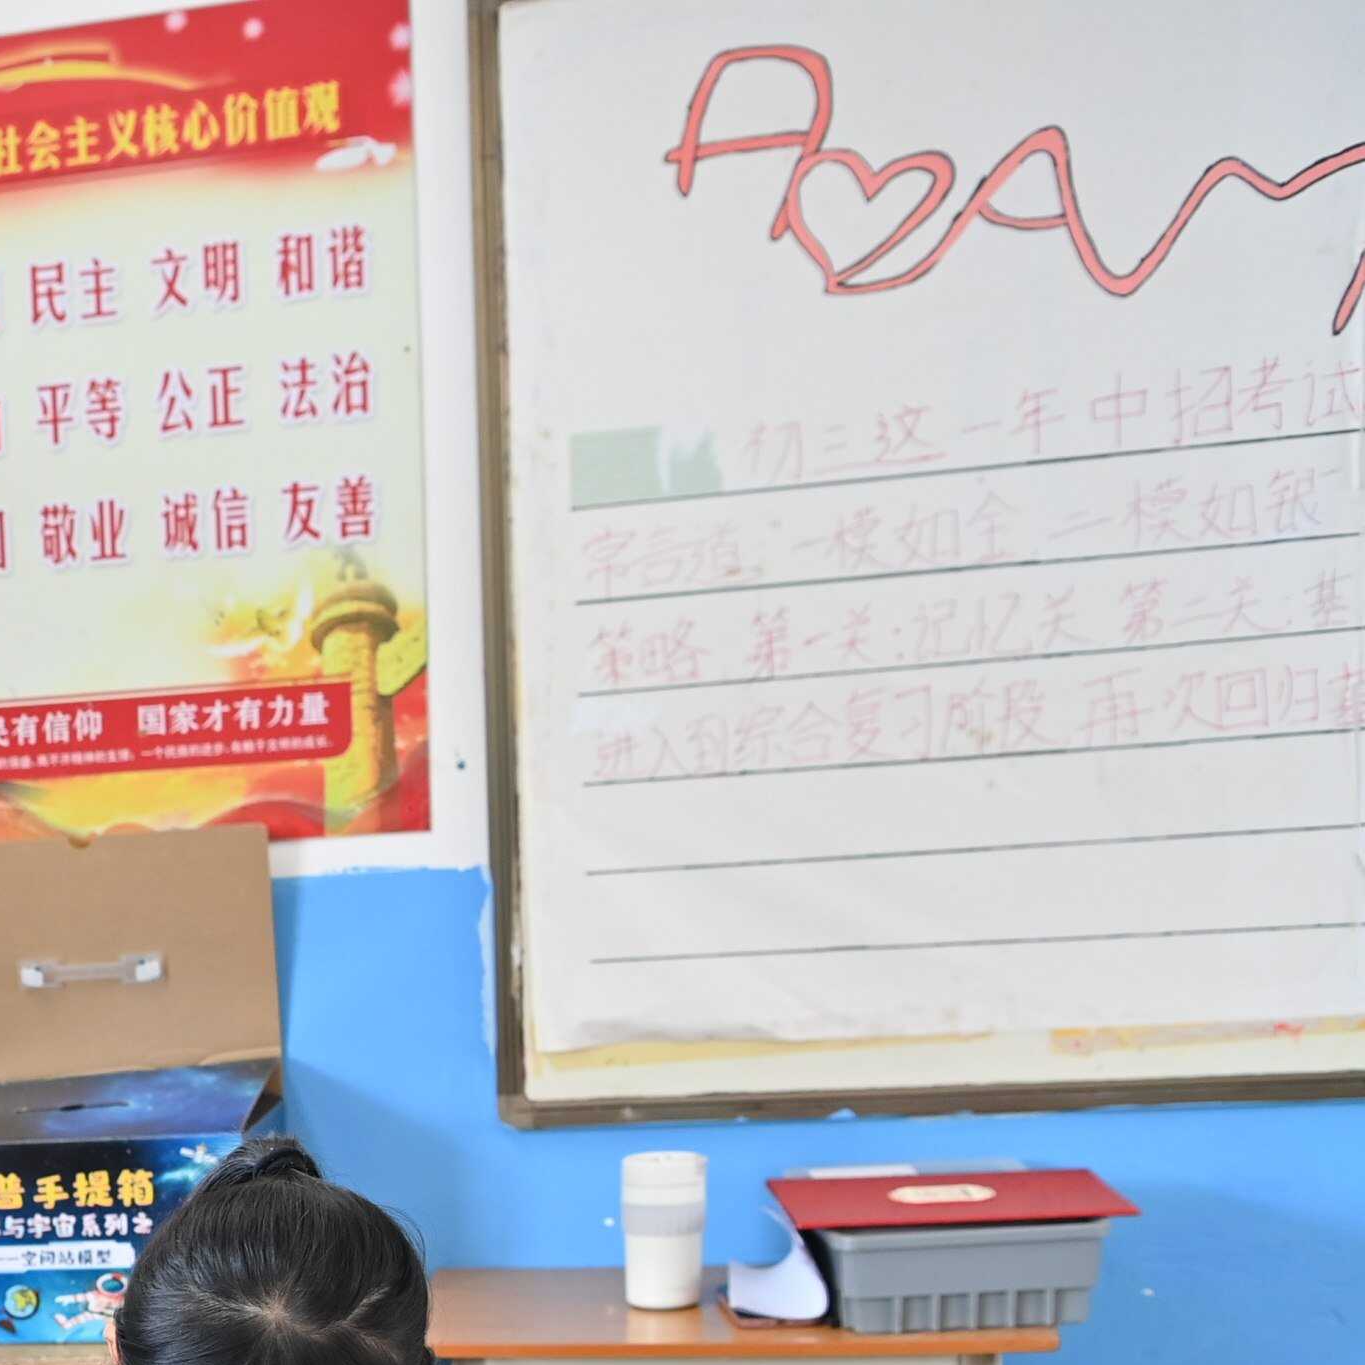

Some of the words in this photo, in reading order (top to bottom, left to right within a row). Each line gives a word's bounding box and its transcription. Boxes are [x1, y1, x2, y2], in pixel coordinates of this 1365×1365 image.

[30, 258, 117, 326] 民主
[151, 240, 241, 311] 文明
[277, 225, 367, 297] 和谐
[36, 379, 122, 446] 平等
[156, 366, 245, 433] 公正
[279, 351, 371, 419] 法治
[39, 500, 127, 564] 敬业
[162, 488, 249, 552] 诚信
[282, 476, 374, 542] 友善
[137, 692, 330, 736] 国家才有力量
